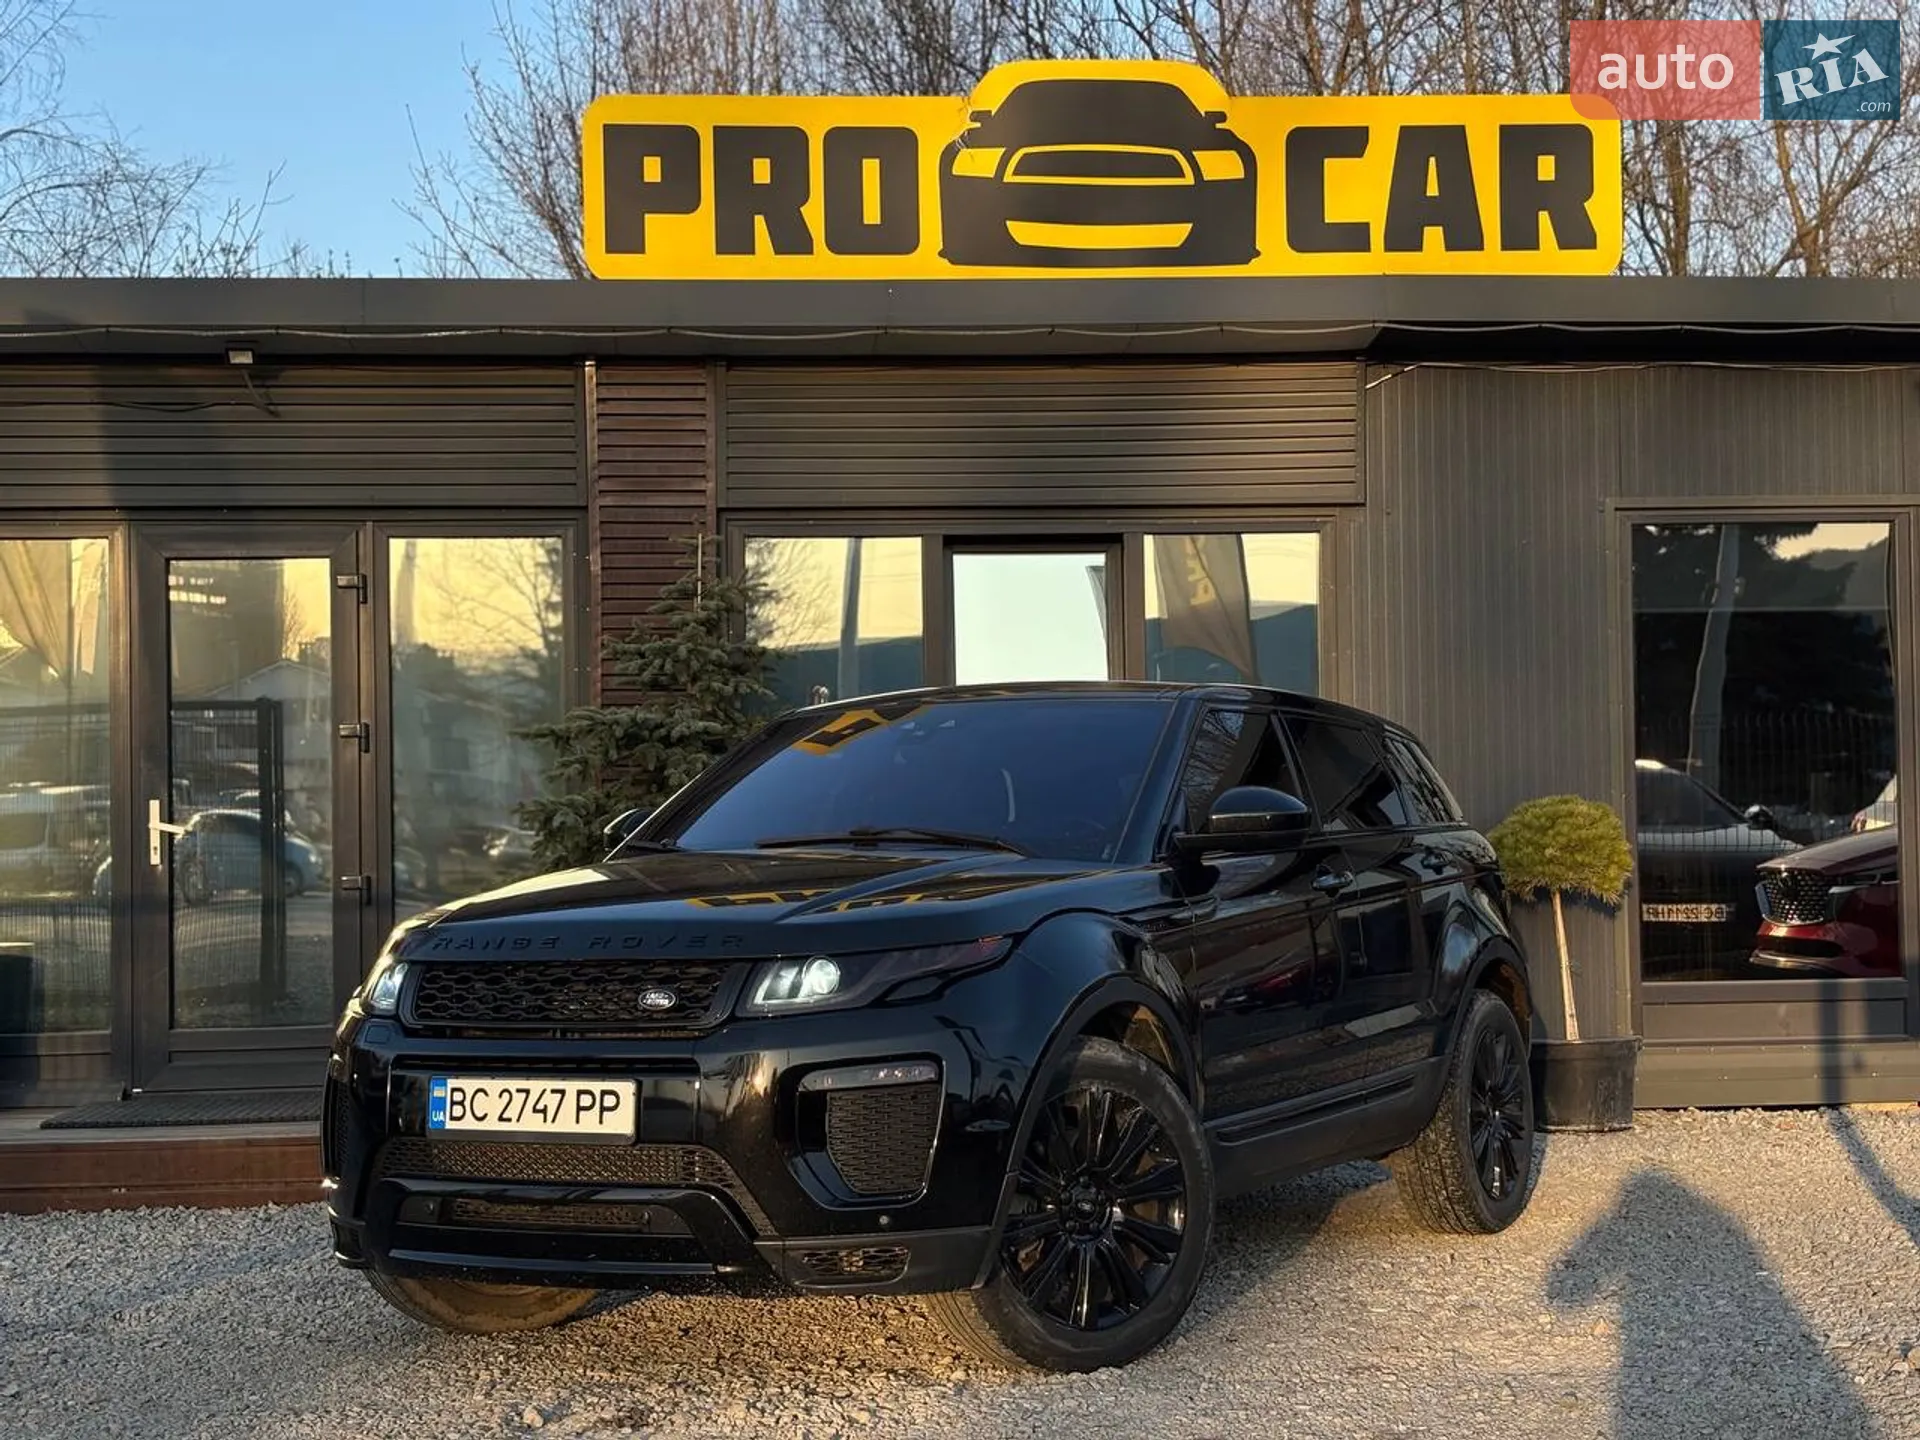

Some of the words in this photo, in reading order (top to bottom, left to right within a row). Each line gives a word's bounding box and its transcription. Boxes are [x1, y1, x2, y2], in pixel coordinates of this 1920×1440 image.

[603, 123, 920, 255] PRO
[1285, 123, 1597, 253] CAR
[432, 935, 560, 950] RANGE
[588, 935, 745, 949] ROVER
[432, 1111, 445, 1121] UA
[449, 1087, 489, 1122] BC
[497, 1088, 566, 1123] 2747
[575, 1089, 620, 1124] PP
